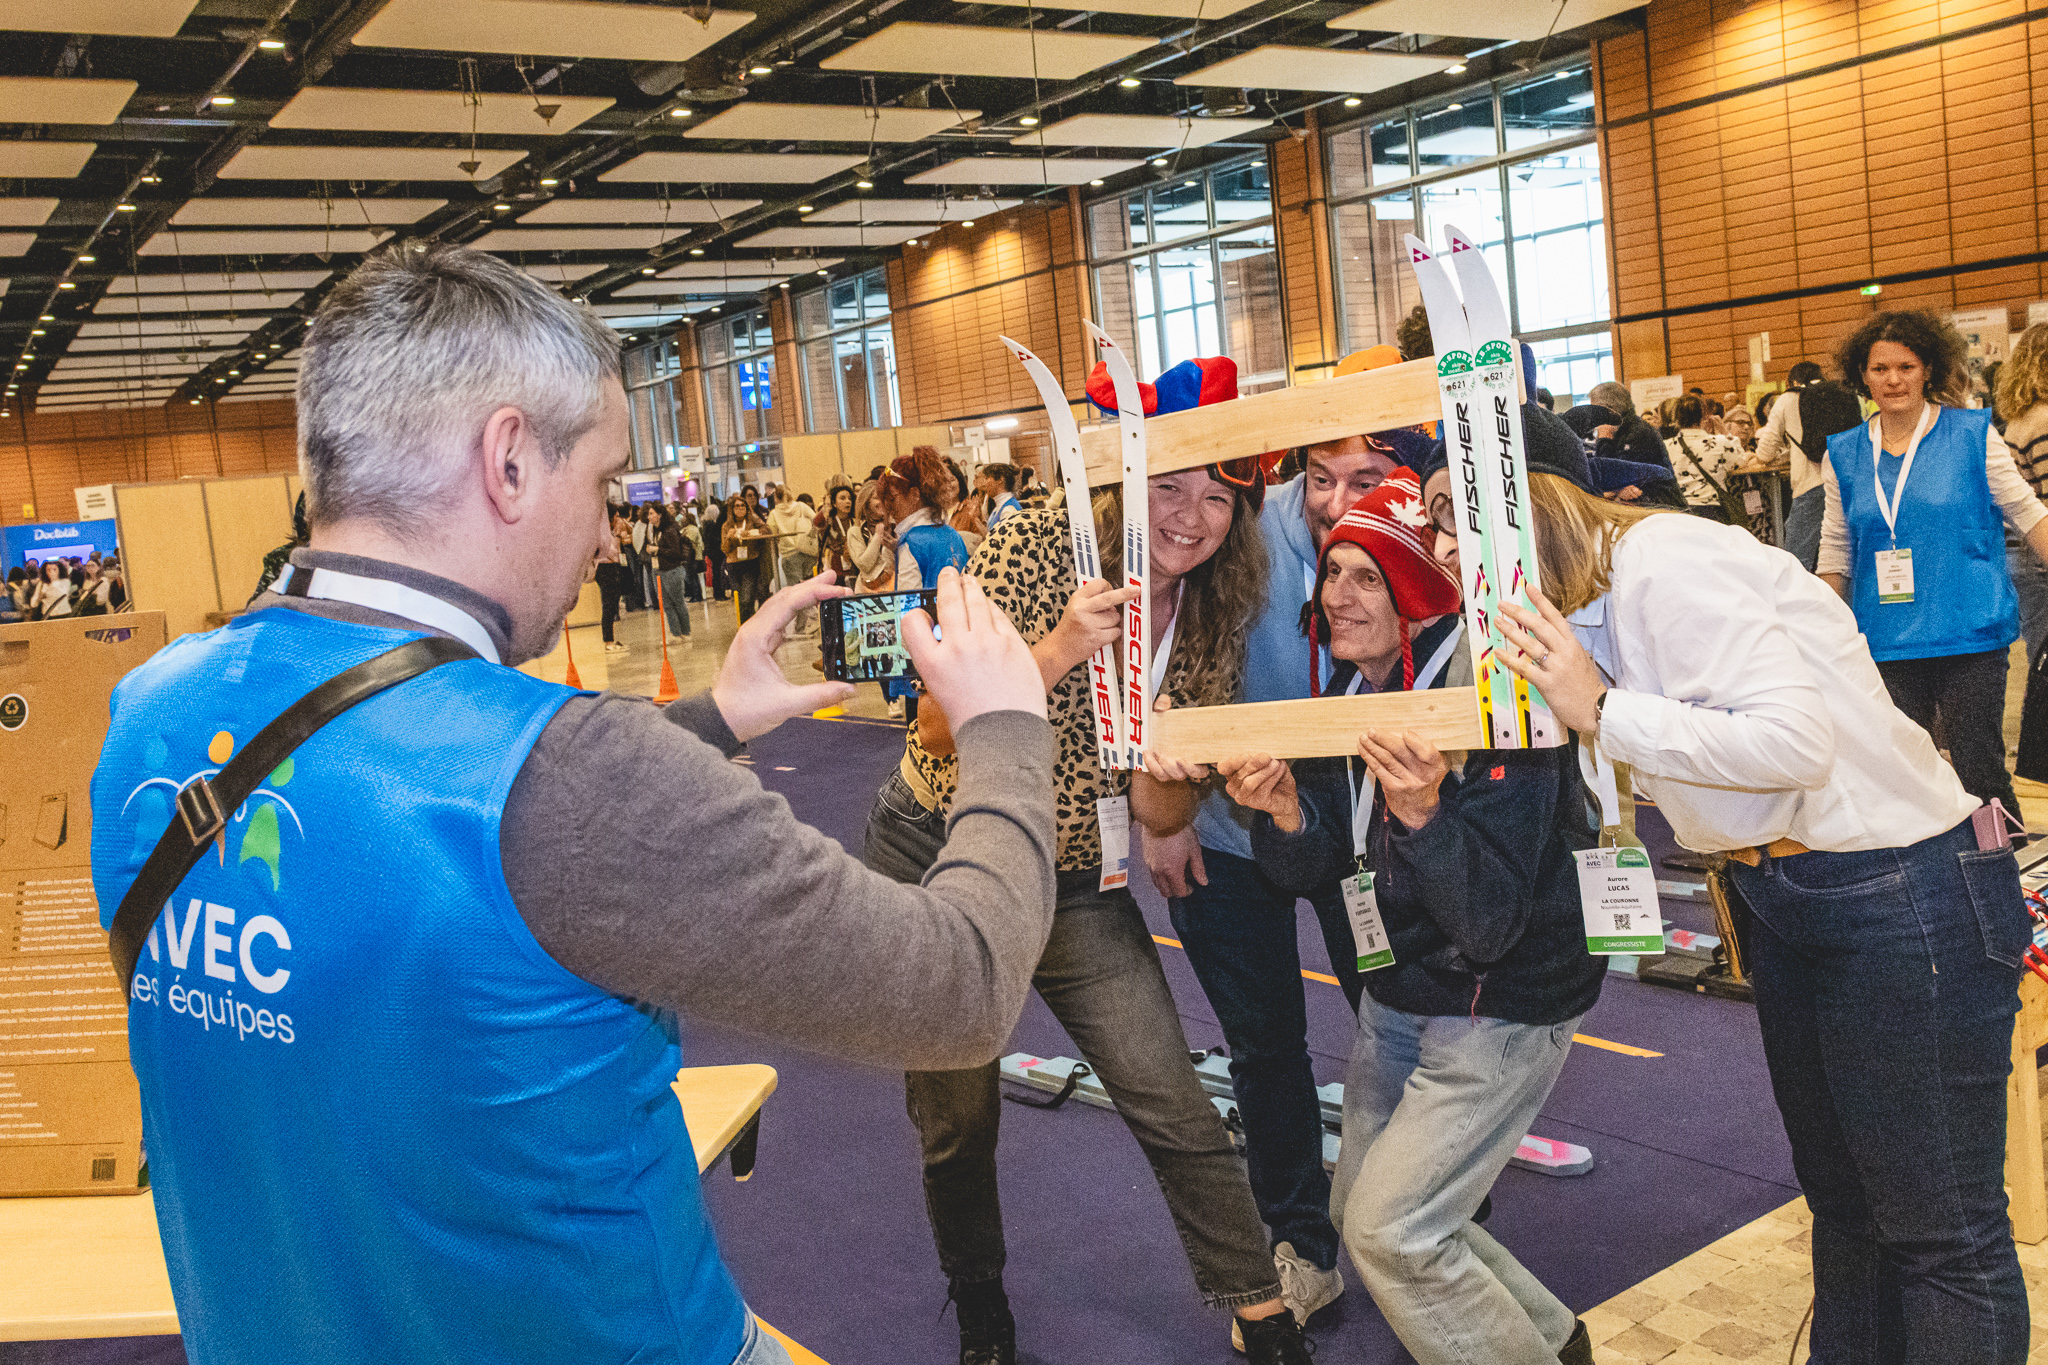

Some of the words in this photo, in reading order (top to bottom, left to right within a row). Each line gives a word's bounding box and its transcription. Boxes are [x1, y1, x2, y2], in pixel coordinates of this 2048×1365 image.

[1452, 380, 1466, 389] 621
[1490, 372, 1503, 380] 621
[1456, 402, 1483, 535] FISCHER
[1494, 395, 1521, 531] FISCHER
[33, 526, 79, 540] Doctolib
[147, 897, 292, 994] VEC
[168, 974, 295, 1044] équipes
